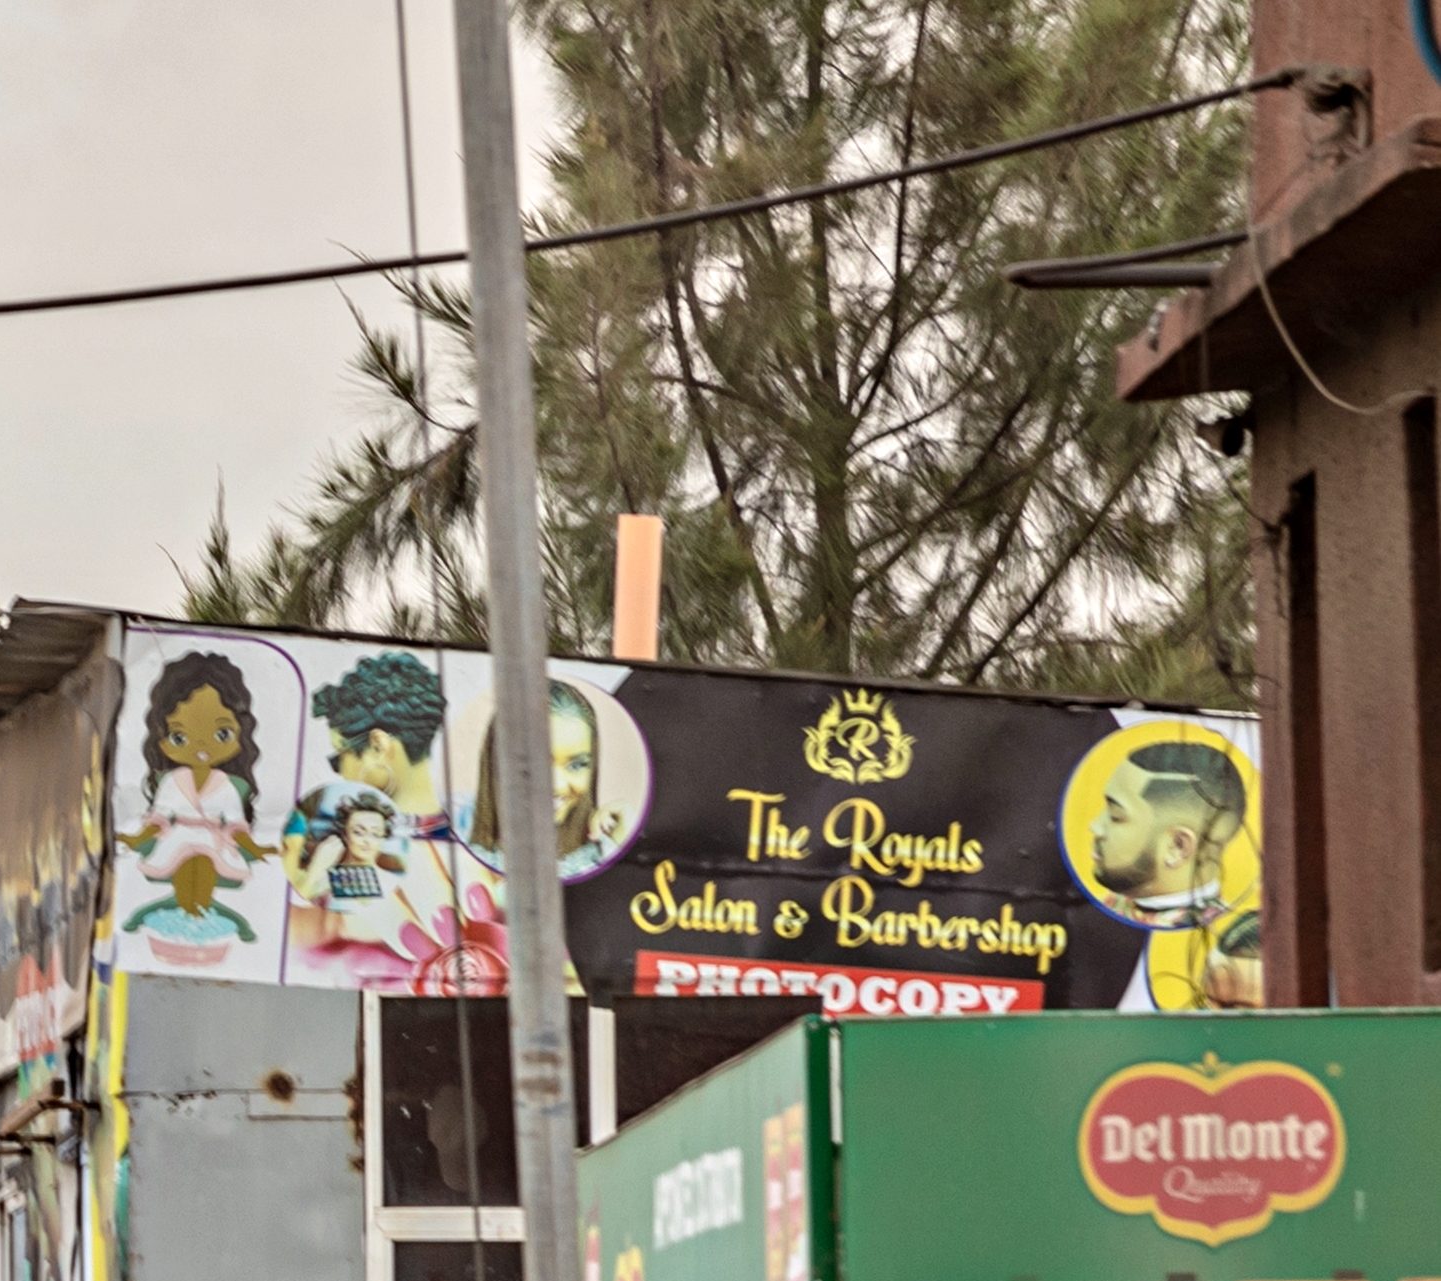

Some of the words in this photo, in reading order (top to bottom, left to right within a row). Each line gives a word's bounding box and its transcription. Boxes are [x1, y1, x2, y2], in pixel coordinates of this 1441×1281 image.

[726, 788, 812, 862] The
[822, 797, 984, 887] Royals
[630, 859, 761, 936] Salon
[773, 899, 810, 940] &
[821, 874, 1067, 976] Barbershop
[655, 959, 1019, 1017] PHOTOCOPY
[1099, 1113, 1175, 1163] Del
[1179, 1112, 1329, 1162] Monte
